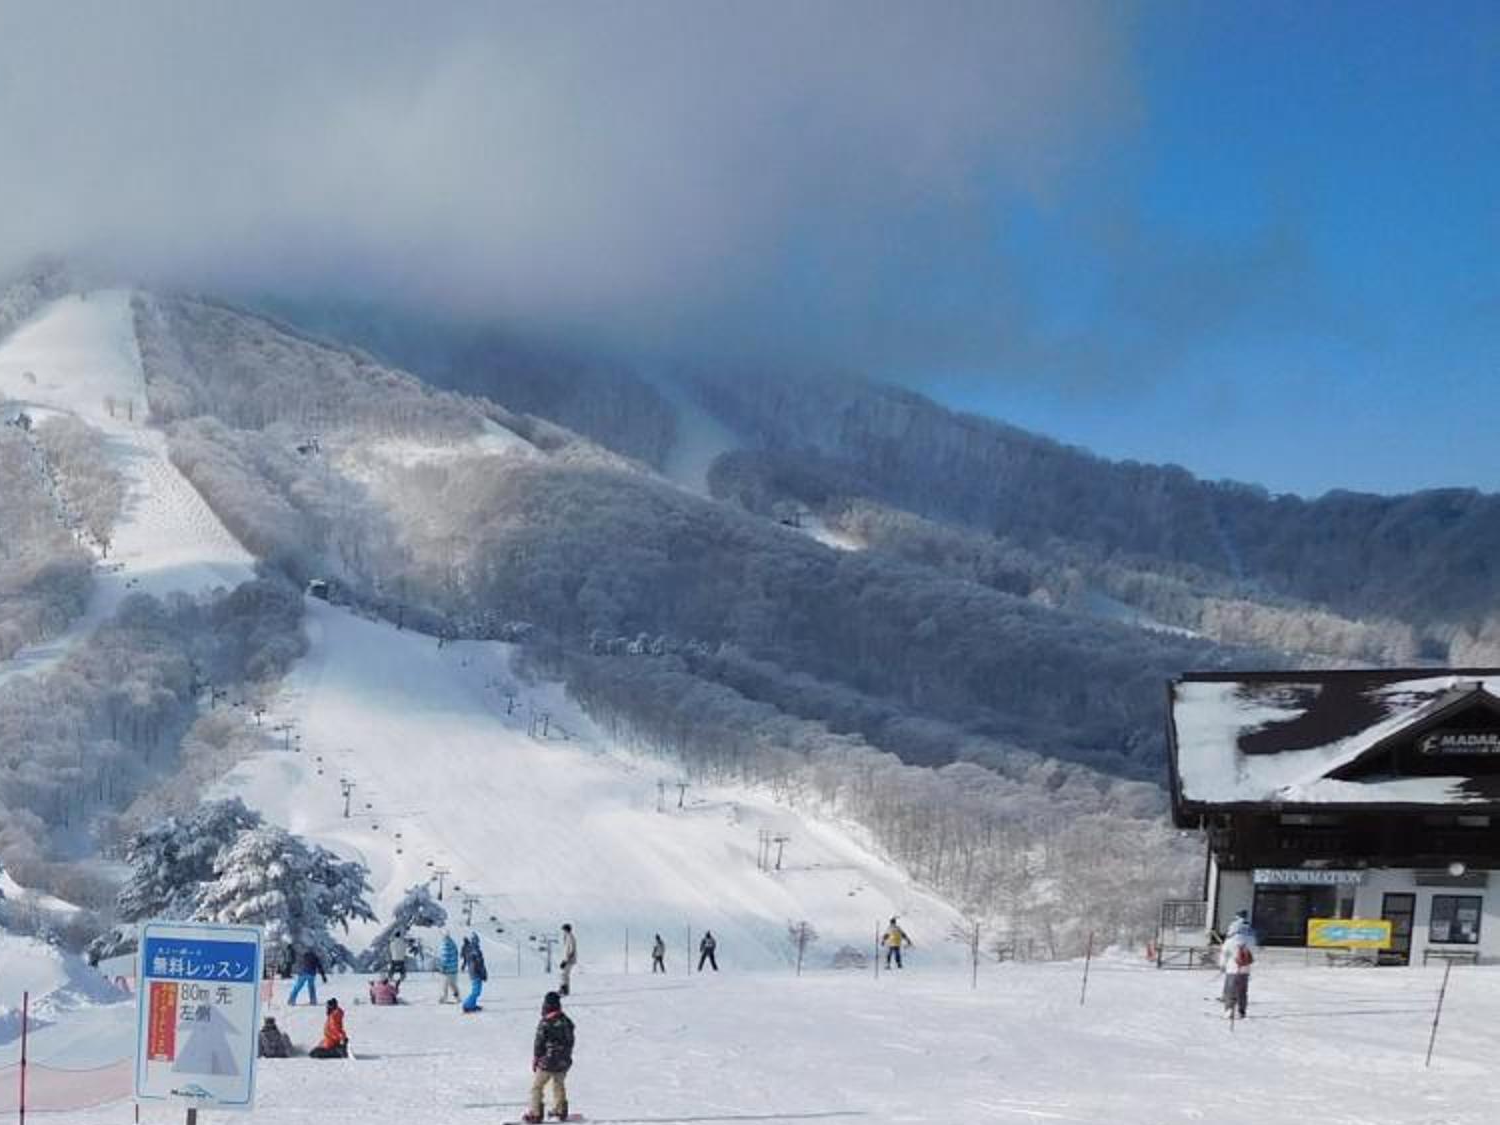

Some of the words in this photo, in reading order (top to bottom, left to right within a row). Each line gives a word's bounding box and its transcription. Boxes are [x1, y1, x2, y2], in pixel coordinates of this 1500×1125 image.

[1268, 869, 1362, 883] INFORMATION
[152, 956, 249, 978] 無料レッスン
[181, 983, 210, 1001] 80m
[180, 1003, 211, 1023] 左側
